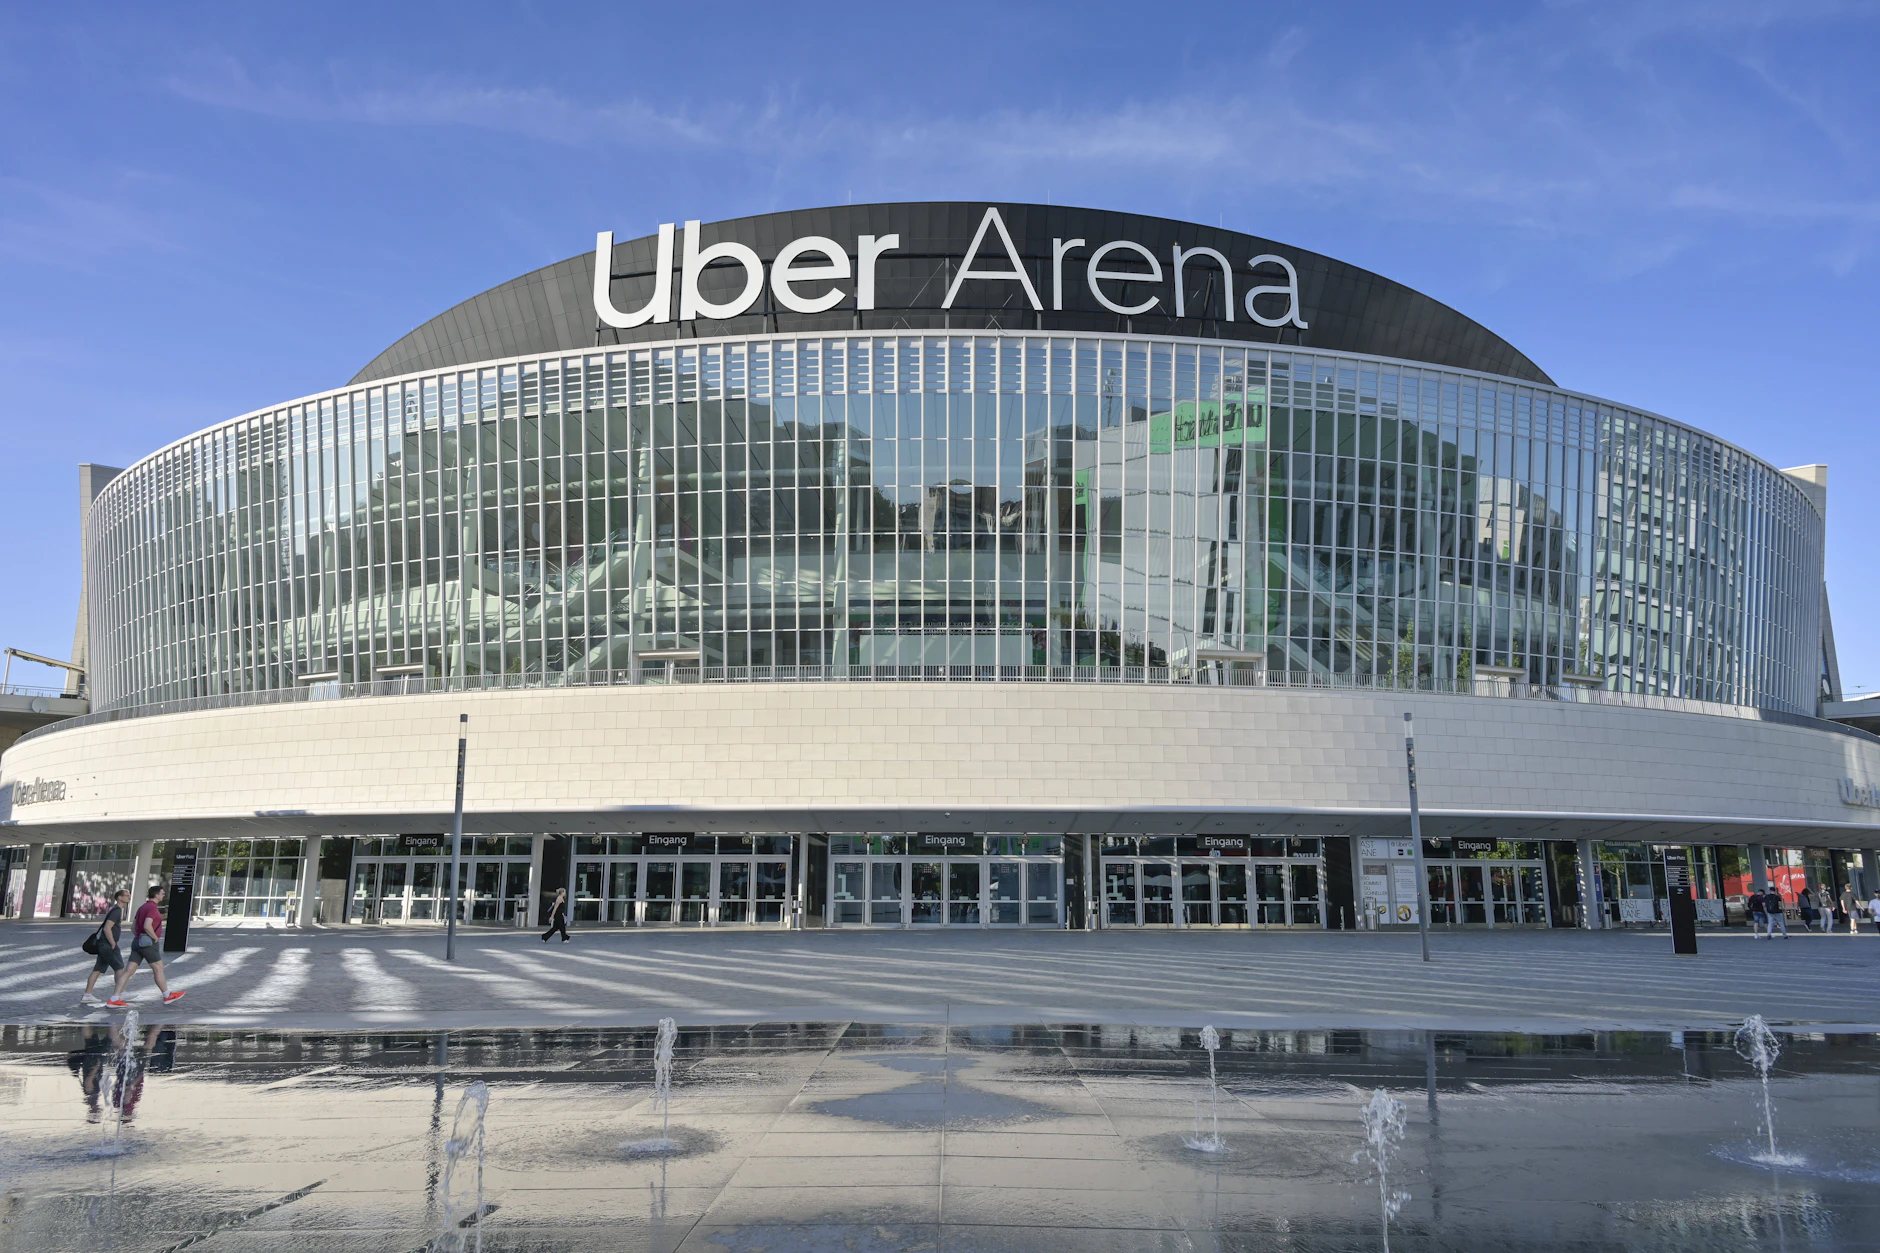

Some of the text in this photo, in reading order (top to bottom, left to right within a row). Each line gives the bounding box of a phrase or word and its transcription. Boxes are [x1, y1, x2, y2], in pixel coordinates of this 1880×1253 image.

[593, 206, 1309, 330] Uber Arena
[405, 836, 438, 847] Eingang
[649, 835, 687, 846] Eingang
[925, 835, 966, 846] Eingang
[1205, 837, 1244, 848] Eingang
[1458, 840, 1492, 851] Eingang
[1621, 901, 1639, 909] FAST
[1622, 910, 1641, 918] LANE
